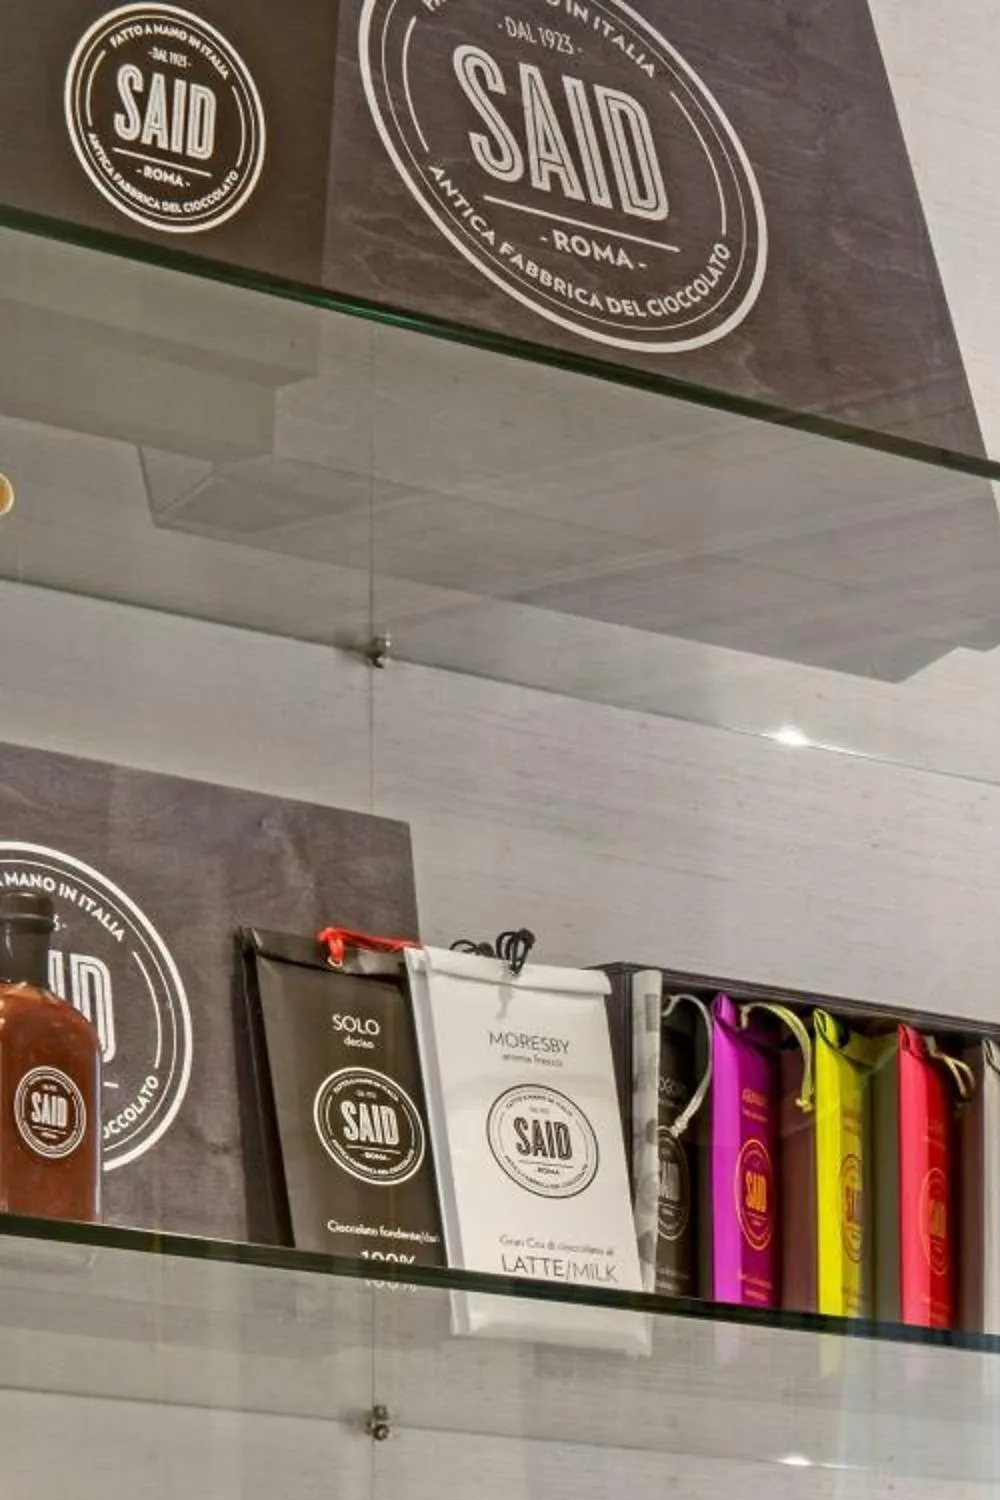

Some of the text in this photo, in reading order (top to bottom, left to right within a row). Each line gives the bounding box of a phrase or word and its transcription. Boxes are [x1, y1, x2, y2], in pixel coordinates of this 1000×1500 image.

[109, 24, 229, 80] FATTO A MANO IN ITALIA
[504, 15, 575, 55] DAL 1923
[565, 0, 656, 78] IN ITALIA
[113, 63, 217, 160] SAID
[452, 44, 669, 221] SAID
[88, 132, 239, 214] ANTICA FABBRICA DEL CIOCCOLATO
[143, 165, 184, 188] ROMA
[427, 164, 732, 318] ANTICA FABBRICA DEL CIOCCOLATO
[552, 229, 636, 271] ROMA
[4, 871, 56, 892] MANO
[59, 882, 78, 902] IN
[78, 893, 125, 943] ITALIA
[332, 1013, 380, 1036] SOLO
[489, 1032, 570, 1055] MORESBY
[31, 1091, 68, 1129] SAID
[103, 1075, 159, 1140] CCOLATO
[340, 1100, 400, 1145] SAID
[513, 1116, 573, 1161] SAID
[501, 1253, 619, 1283] LATTE/MILK
